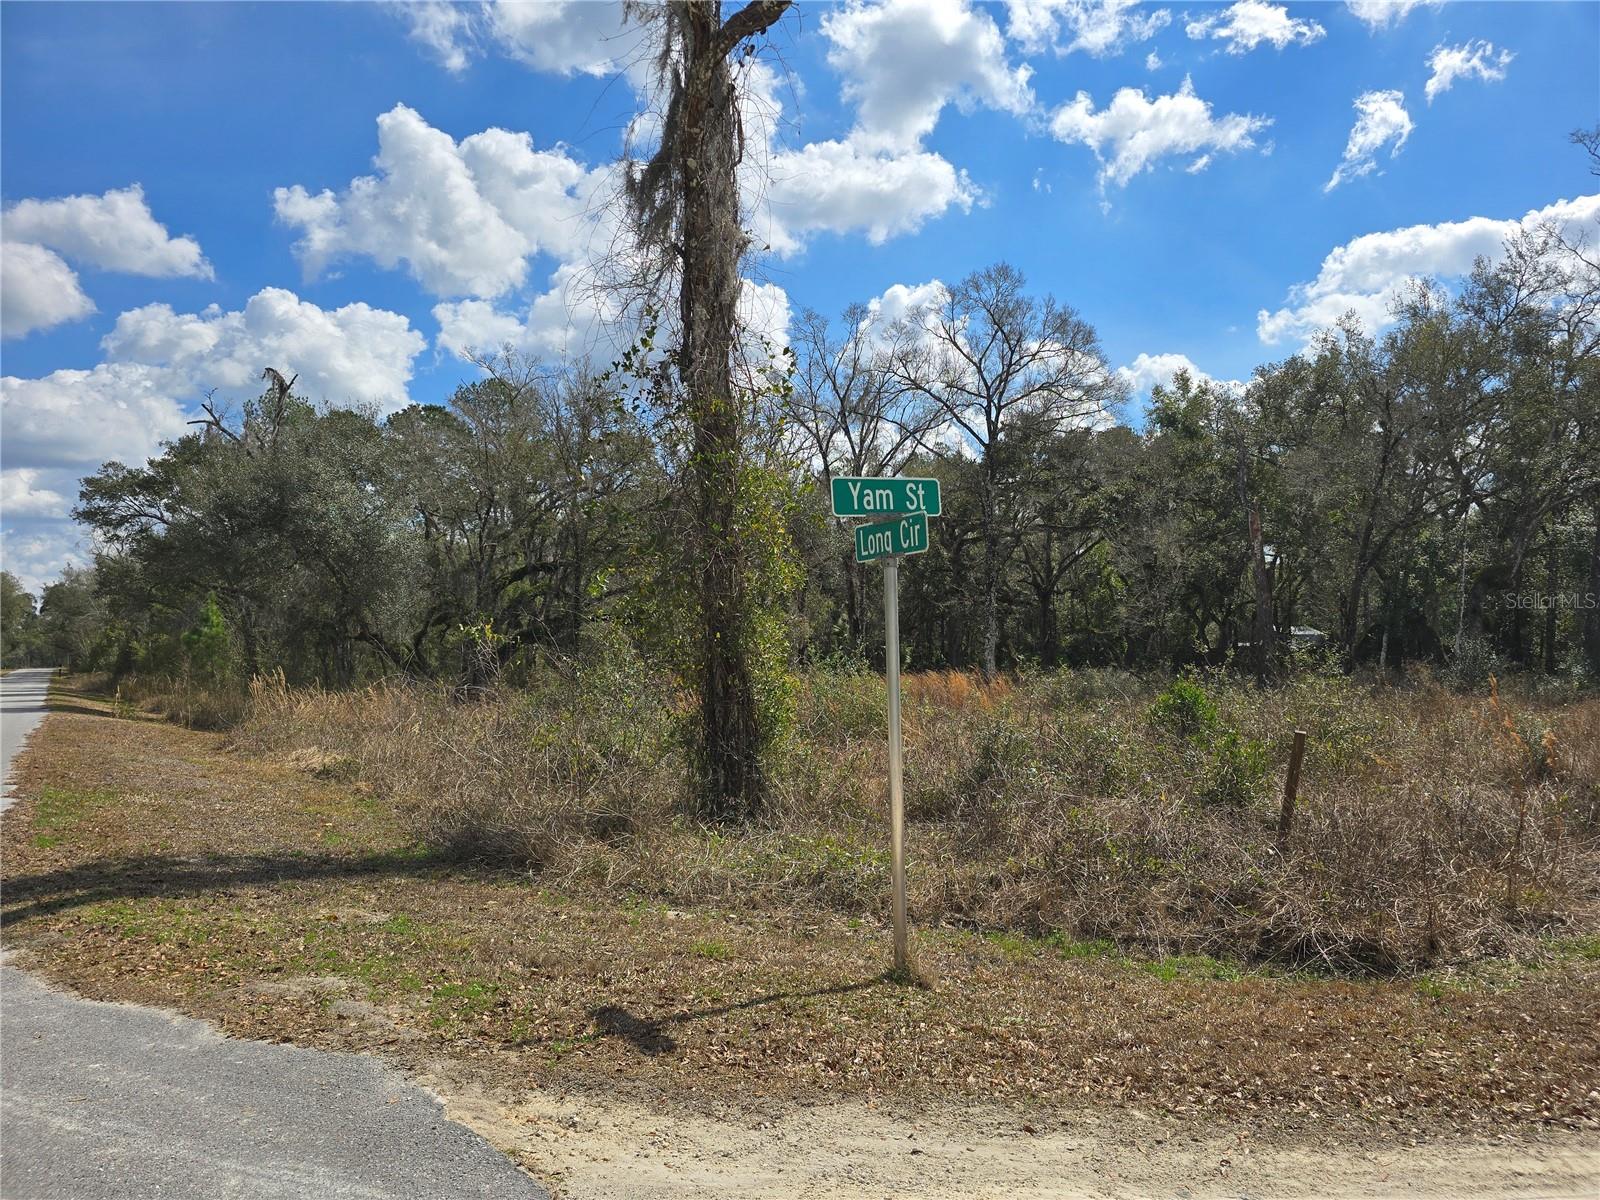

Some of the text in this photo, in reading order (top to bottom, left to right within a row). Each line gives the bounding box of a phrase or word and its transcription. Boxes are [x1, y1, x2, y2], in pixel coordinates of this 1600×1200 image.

[848, 481, 926, 510] Yam St
[860, 519, 921, 556] Long Cir
